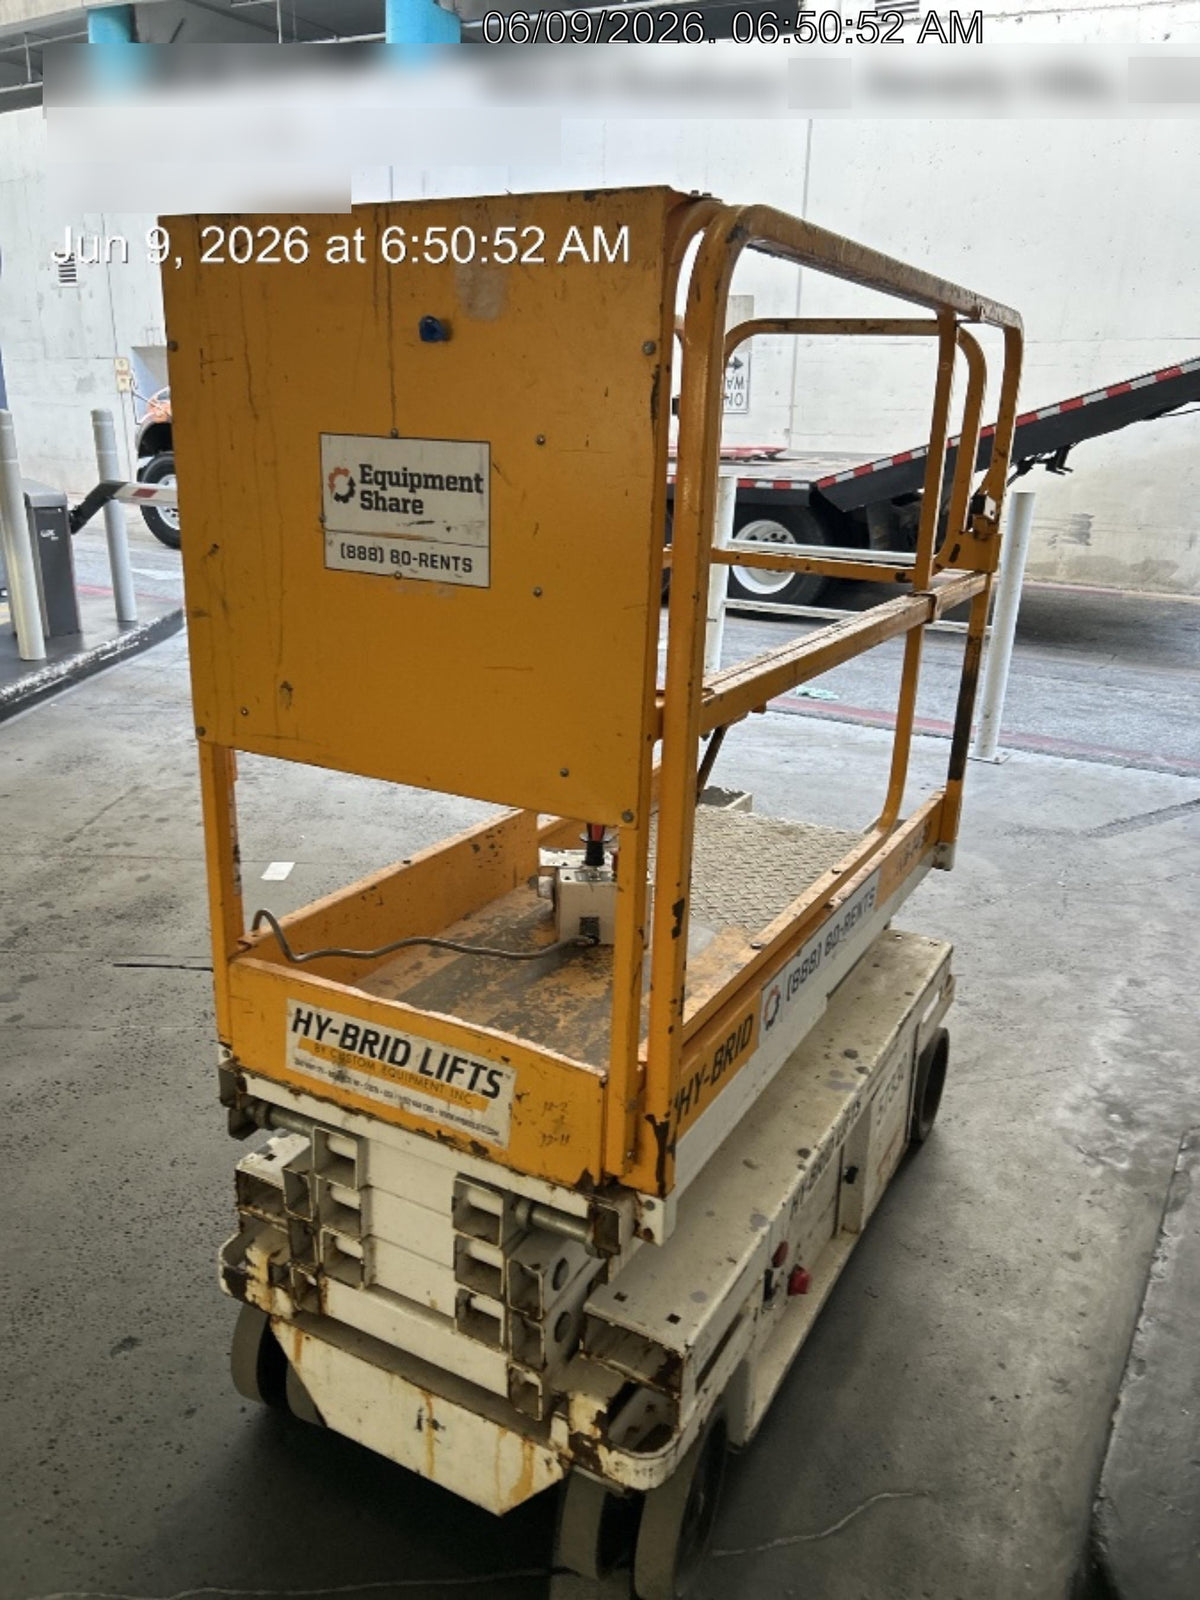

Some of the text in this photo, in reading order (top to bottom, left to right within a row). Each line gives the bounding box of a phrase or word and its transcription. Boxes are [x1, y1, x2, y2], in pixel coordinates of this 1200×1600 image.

[358, 463, 484, 494] Equipment
[360, 489, 424, 516] Share
[340, 542, 385, 564] (888)
[291, 1007, 412, 1068] HY-BRID
[418, 1046, 504, 1100] LIFTS
[382, 1065, 445, 1093] EQUIPMENT
[675, 1013, 754, 1126] HY-BRID
